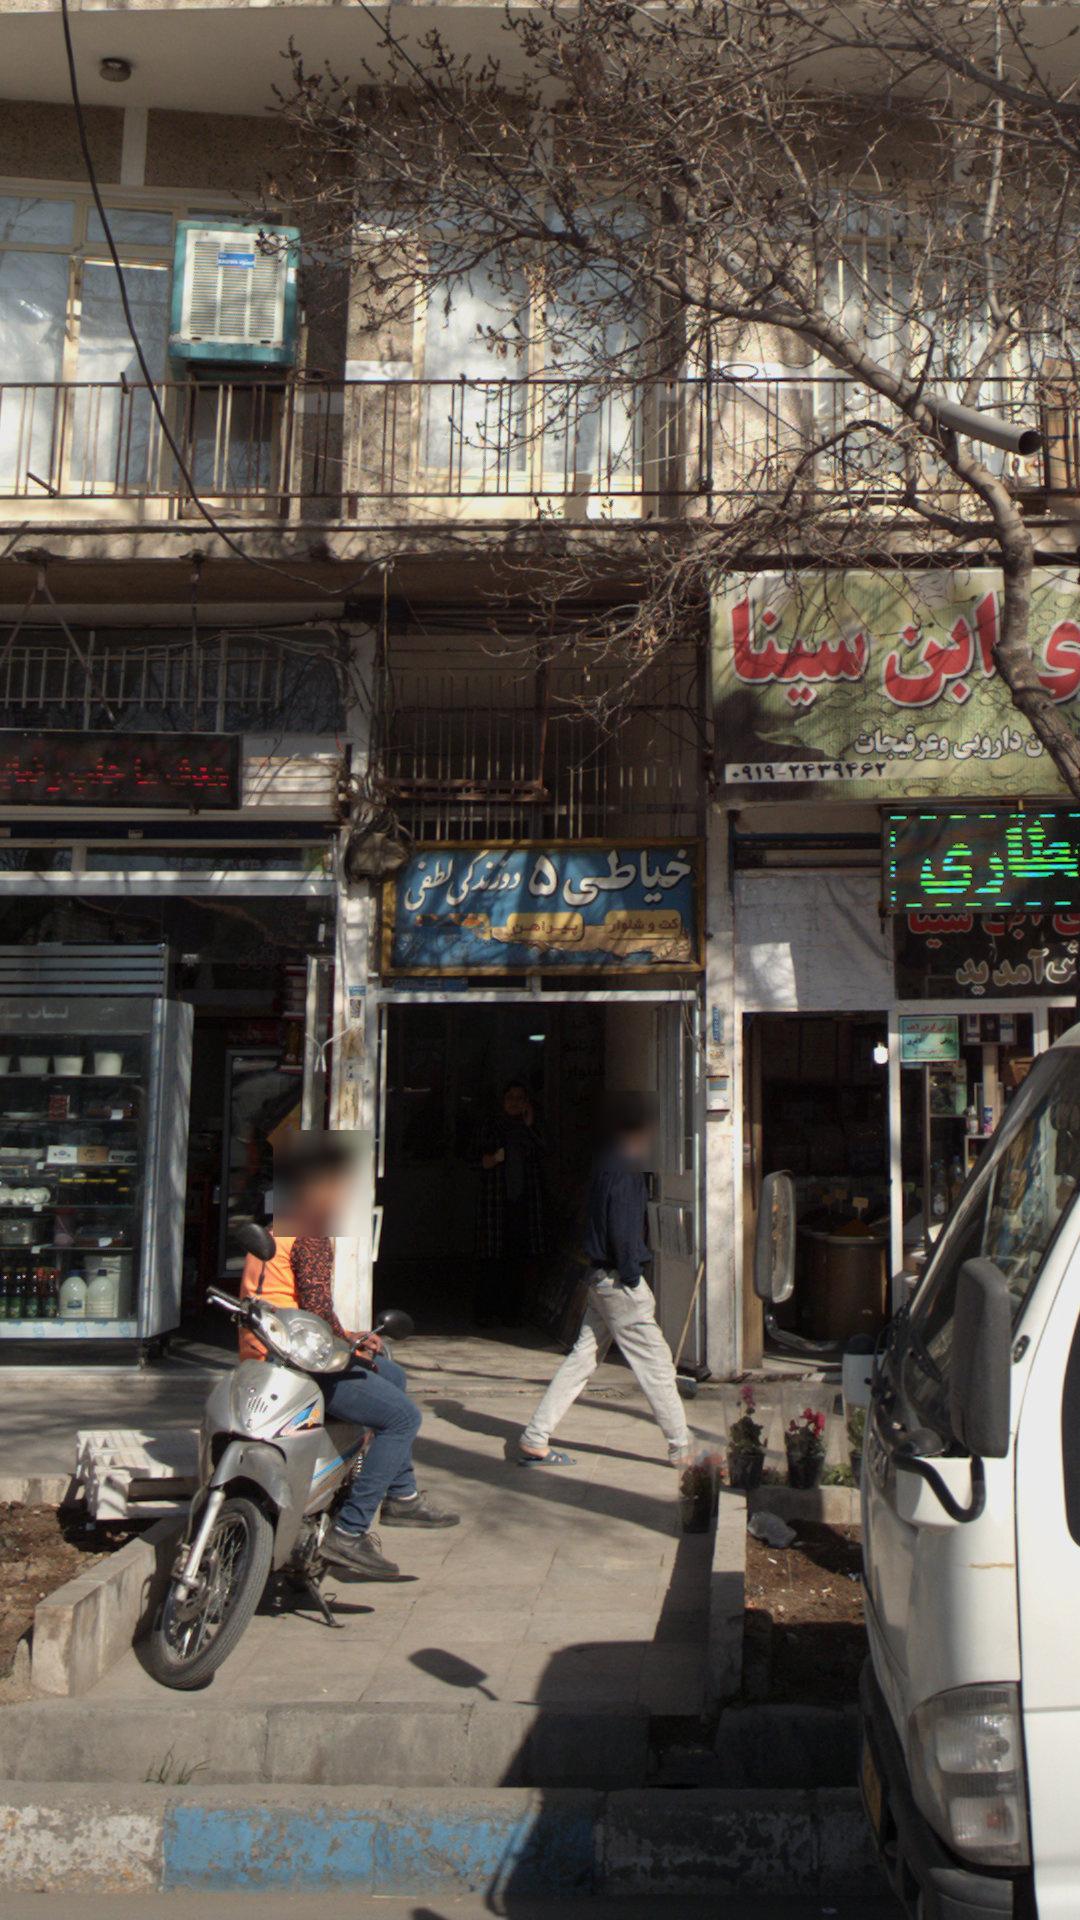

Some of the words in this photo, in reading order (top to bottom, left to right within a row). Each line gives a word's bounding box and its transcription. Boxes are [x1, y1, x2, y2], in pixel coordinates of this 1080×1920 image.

[731, 595, 869, 706] سینا
[884, 591, 998, 707] ابن
[528, 854, 557, 896] ۵
[563, 849, 693, 906] خیاطی
